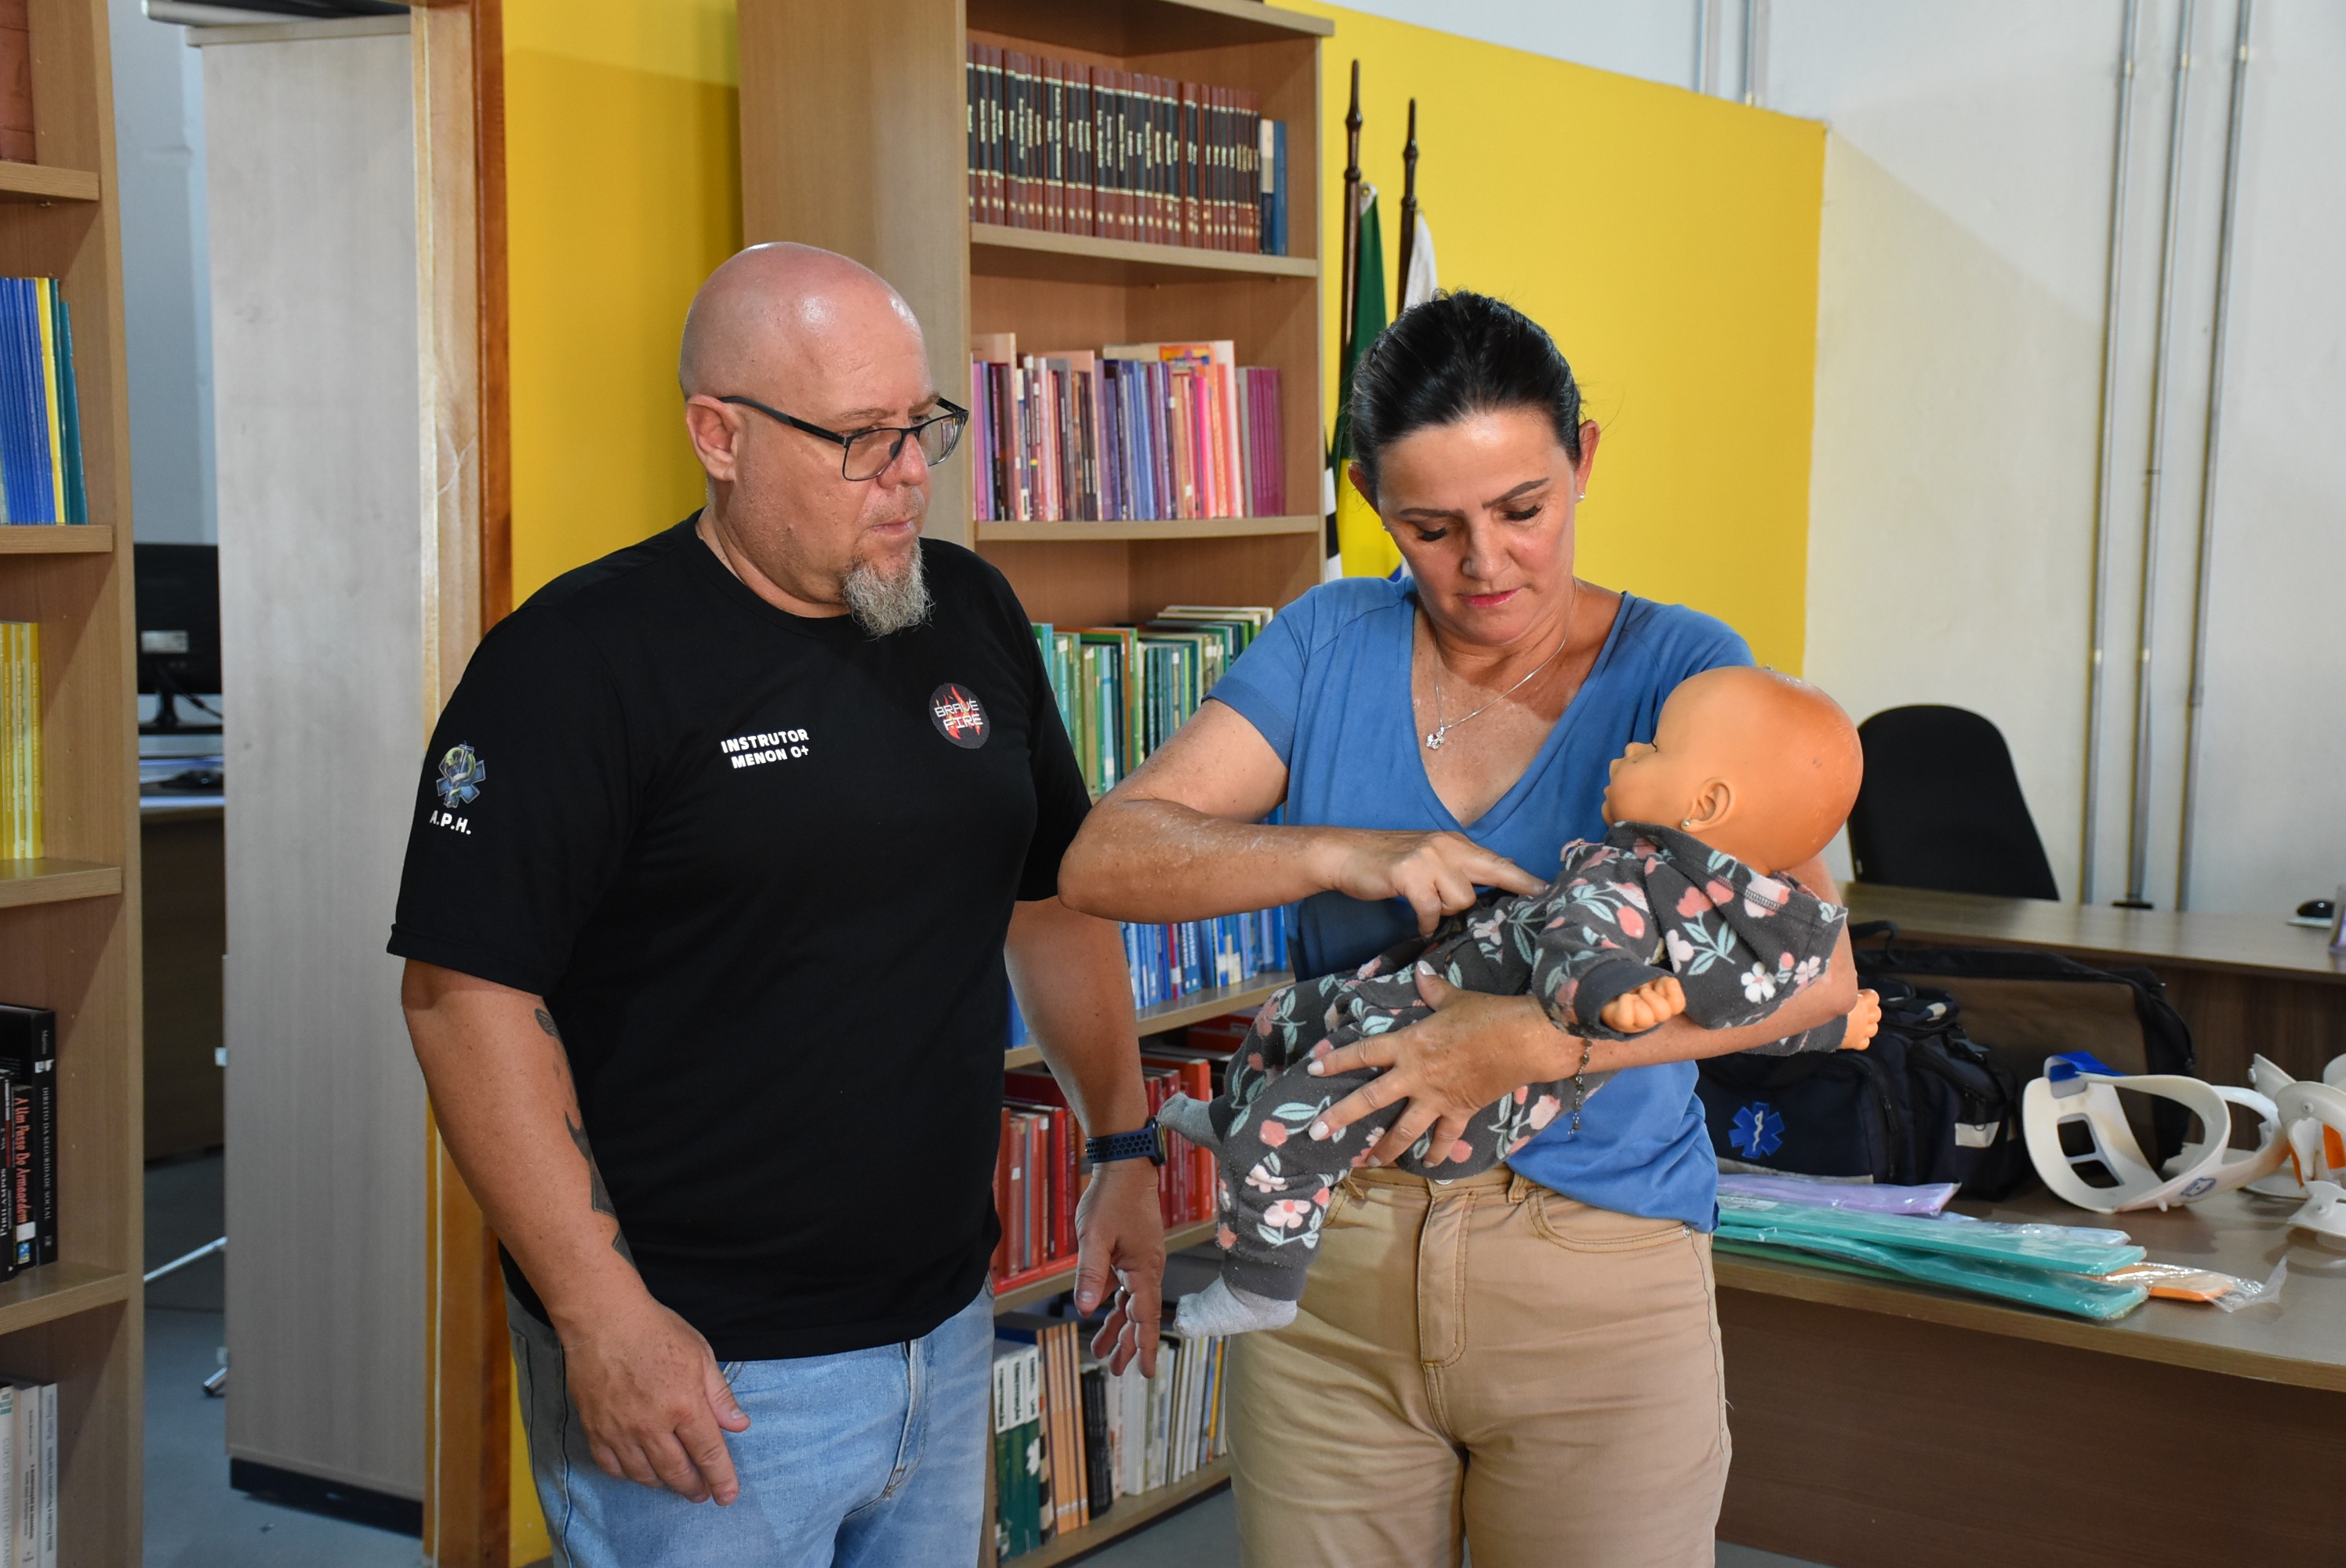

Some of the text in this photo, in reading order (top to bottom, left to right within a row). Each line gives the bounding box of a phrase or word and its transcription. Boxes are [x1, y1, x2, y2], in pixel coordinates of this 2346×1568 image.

[934, 700, 979, 717] BRAVE
[943, 713, 983, 731] FIRE
[721, 728, 809, 753] INSTRUTOR
[731, 748, 787, 769] MENON
[429, 810, 471, 835] A.P.H.
[16, 1107, 31, 1123] Um
[16, 1125, 31, 1150] Passo
[43, 1123, 50, 1135] DA
[16, 1152, 31, 1166] Do
